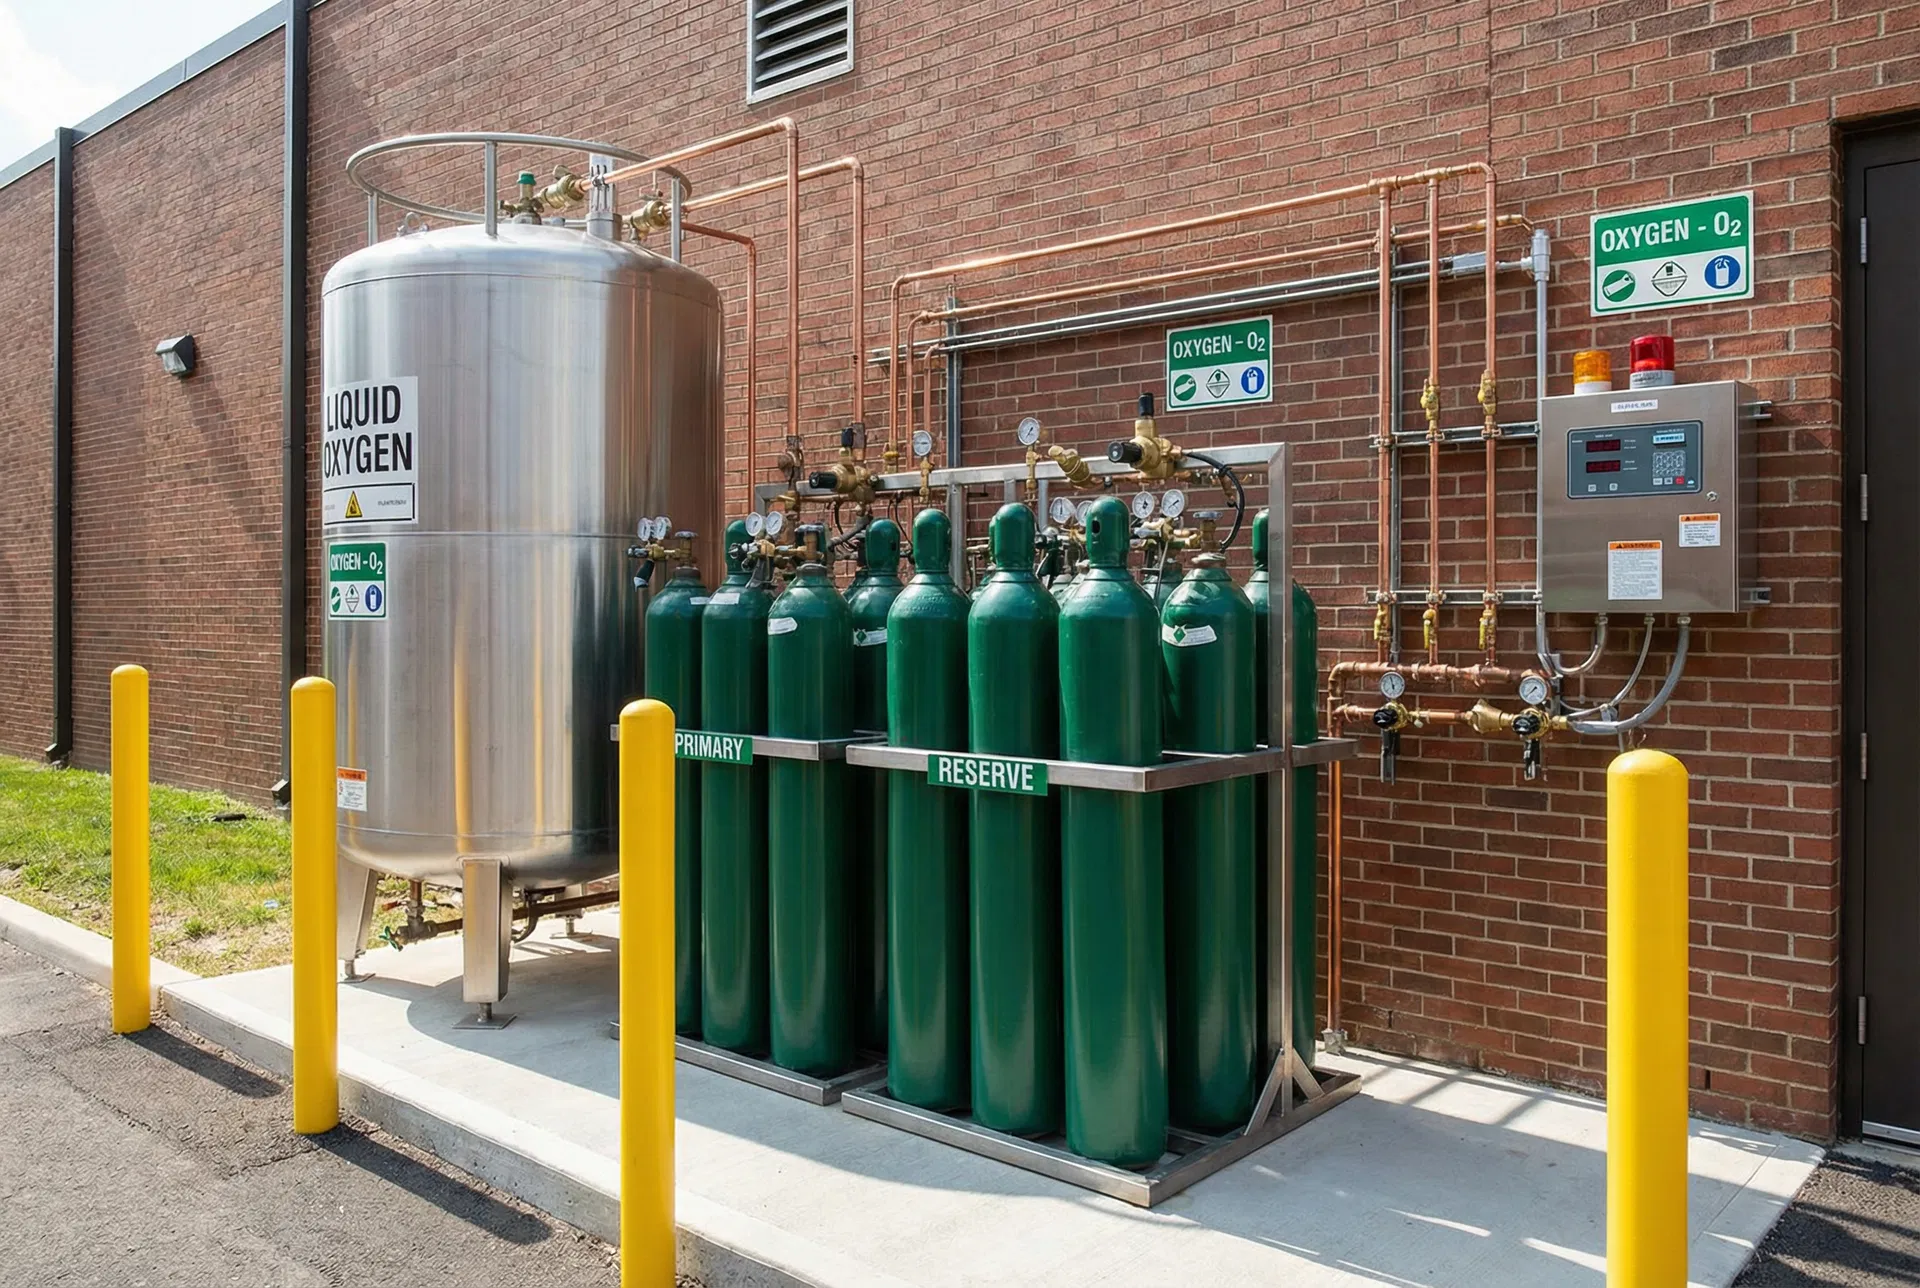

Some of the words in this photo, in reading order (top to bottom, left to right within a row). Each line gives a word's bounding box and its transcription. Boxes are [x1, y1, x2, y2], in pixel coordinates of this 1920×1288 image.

[1600, 217, 1689, 252] OXYGEN
[1713, 211, 1742, 237] O2
[1173, 334, 1232, 359] OXYGEN
[1247, 331, 1266, 352] O2
[327, 385, 401, 432] LIQUID
[324, 432, 412, 478] OXYGEN
[330, 552, 361, 571] OXYGEN
[369, 551, 383, 575] O2
[675, 733, 744, 761] PRIMARY
[939, 757, 1034, 791] RESERVE
